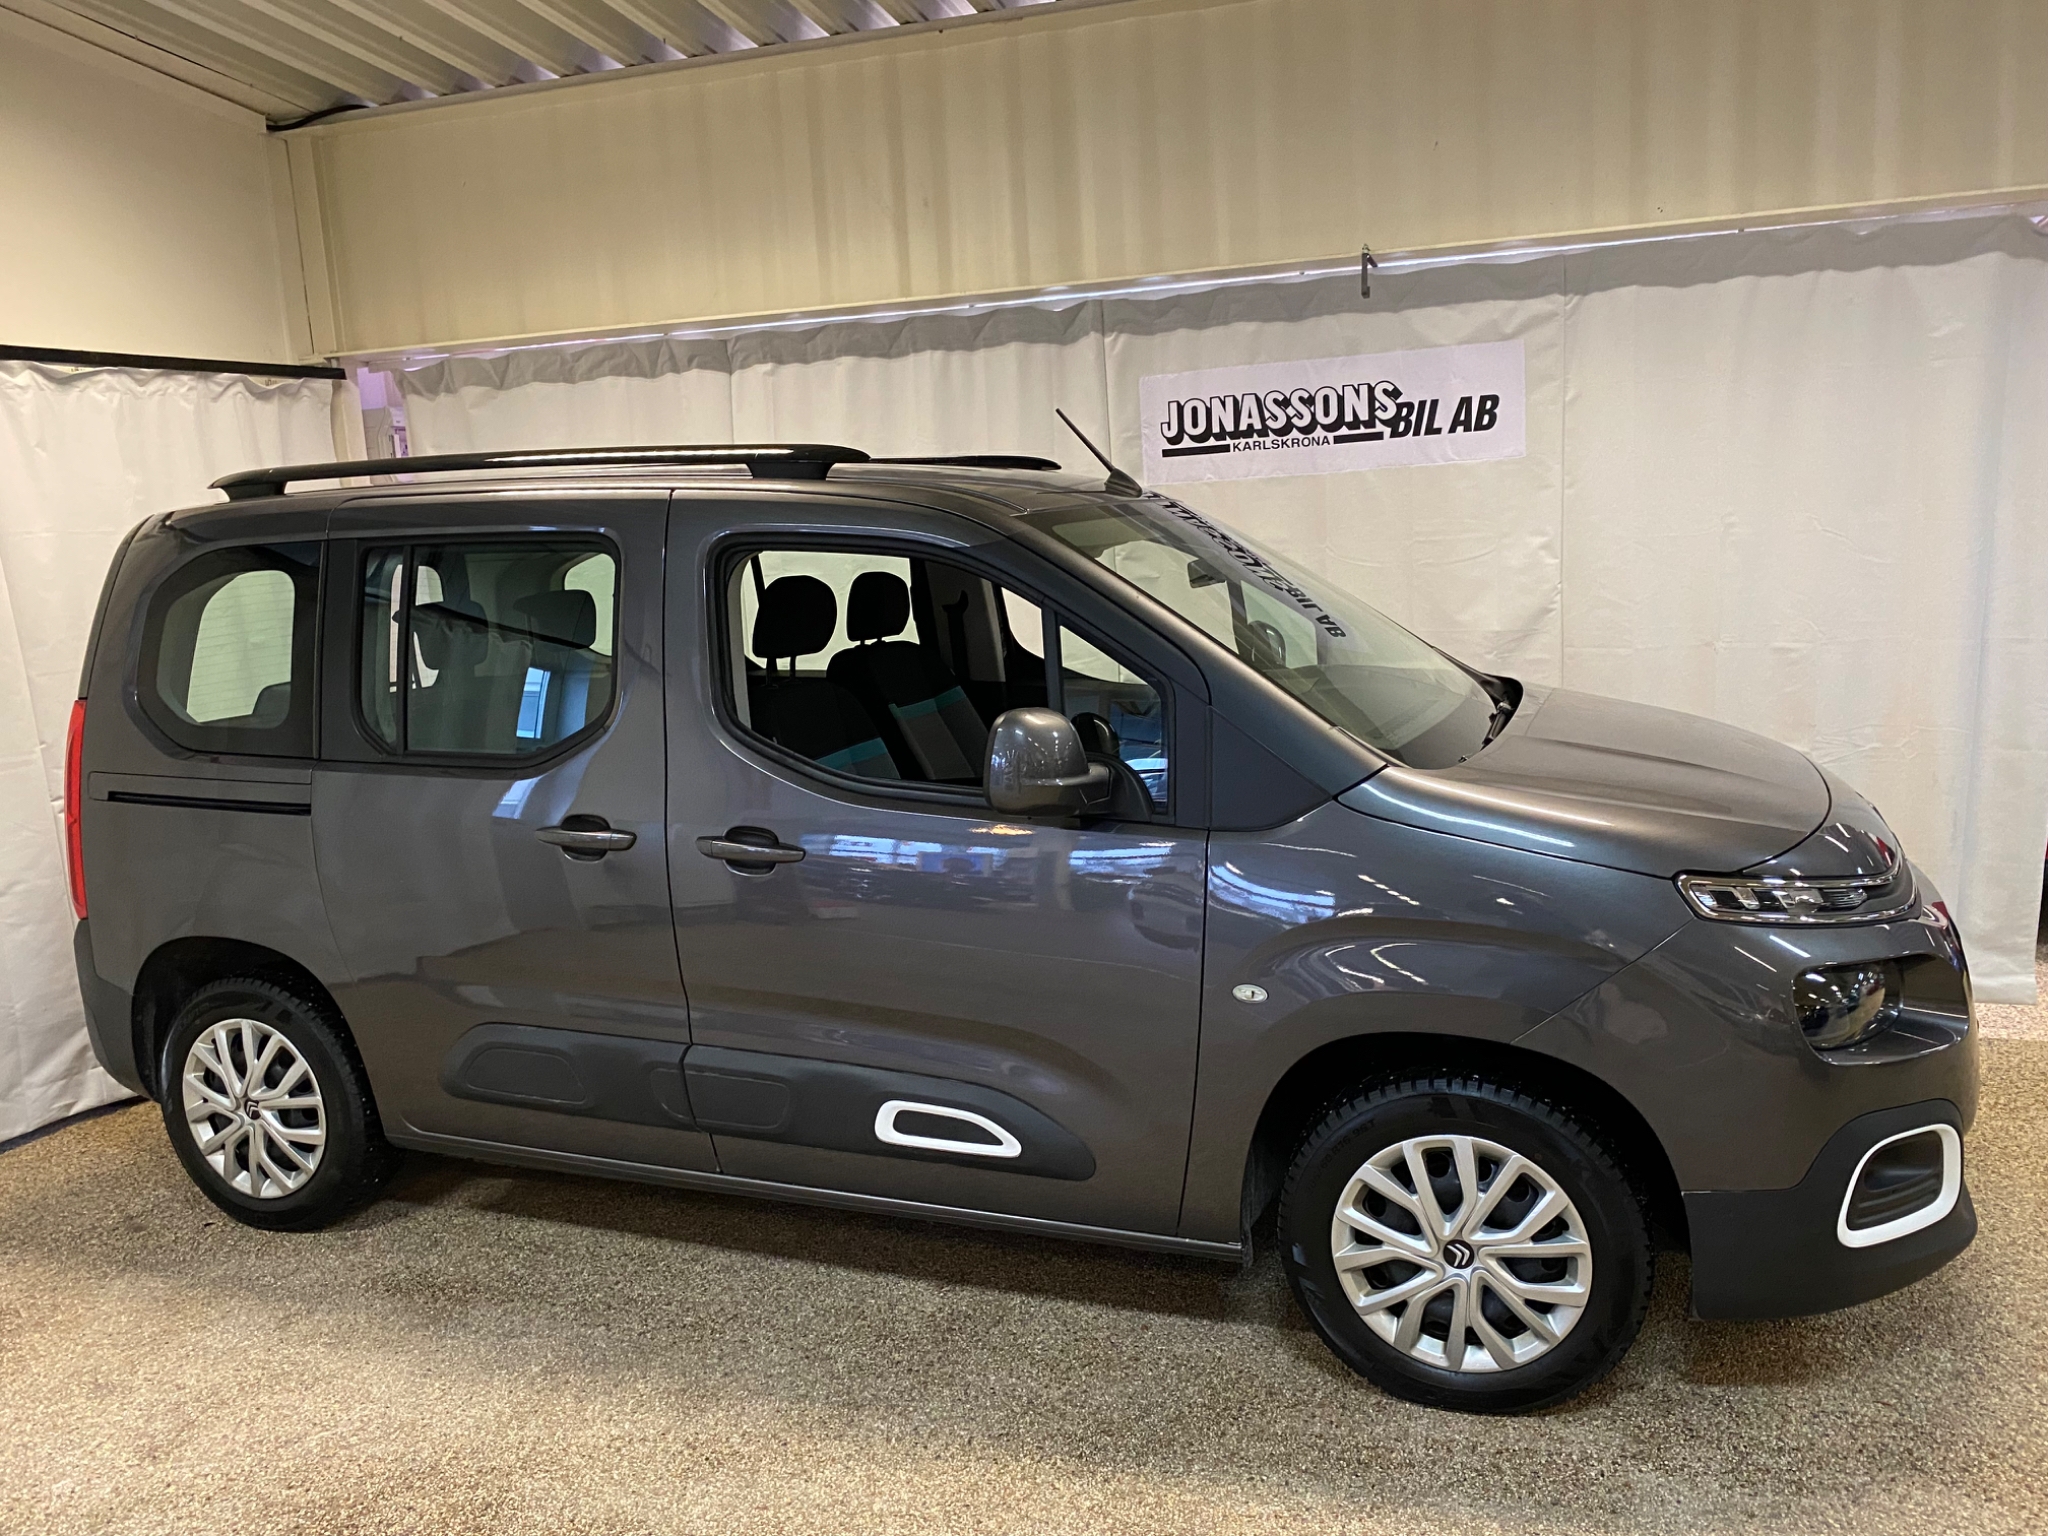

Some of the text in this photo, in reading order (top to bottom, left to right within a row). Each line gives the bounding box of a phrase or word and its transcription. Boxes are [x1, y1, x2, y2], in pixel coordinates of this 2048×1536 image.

[1160, 380, 1501, 446] JONASSONS BIL AB
[1232, 435, 1331, 453] KARLSKRONA
